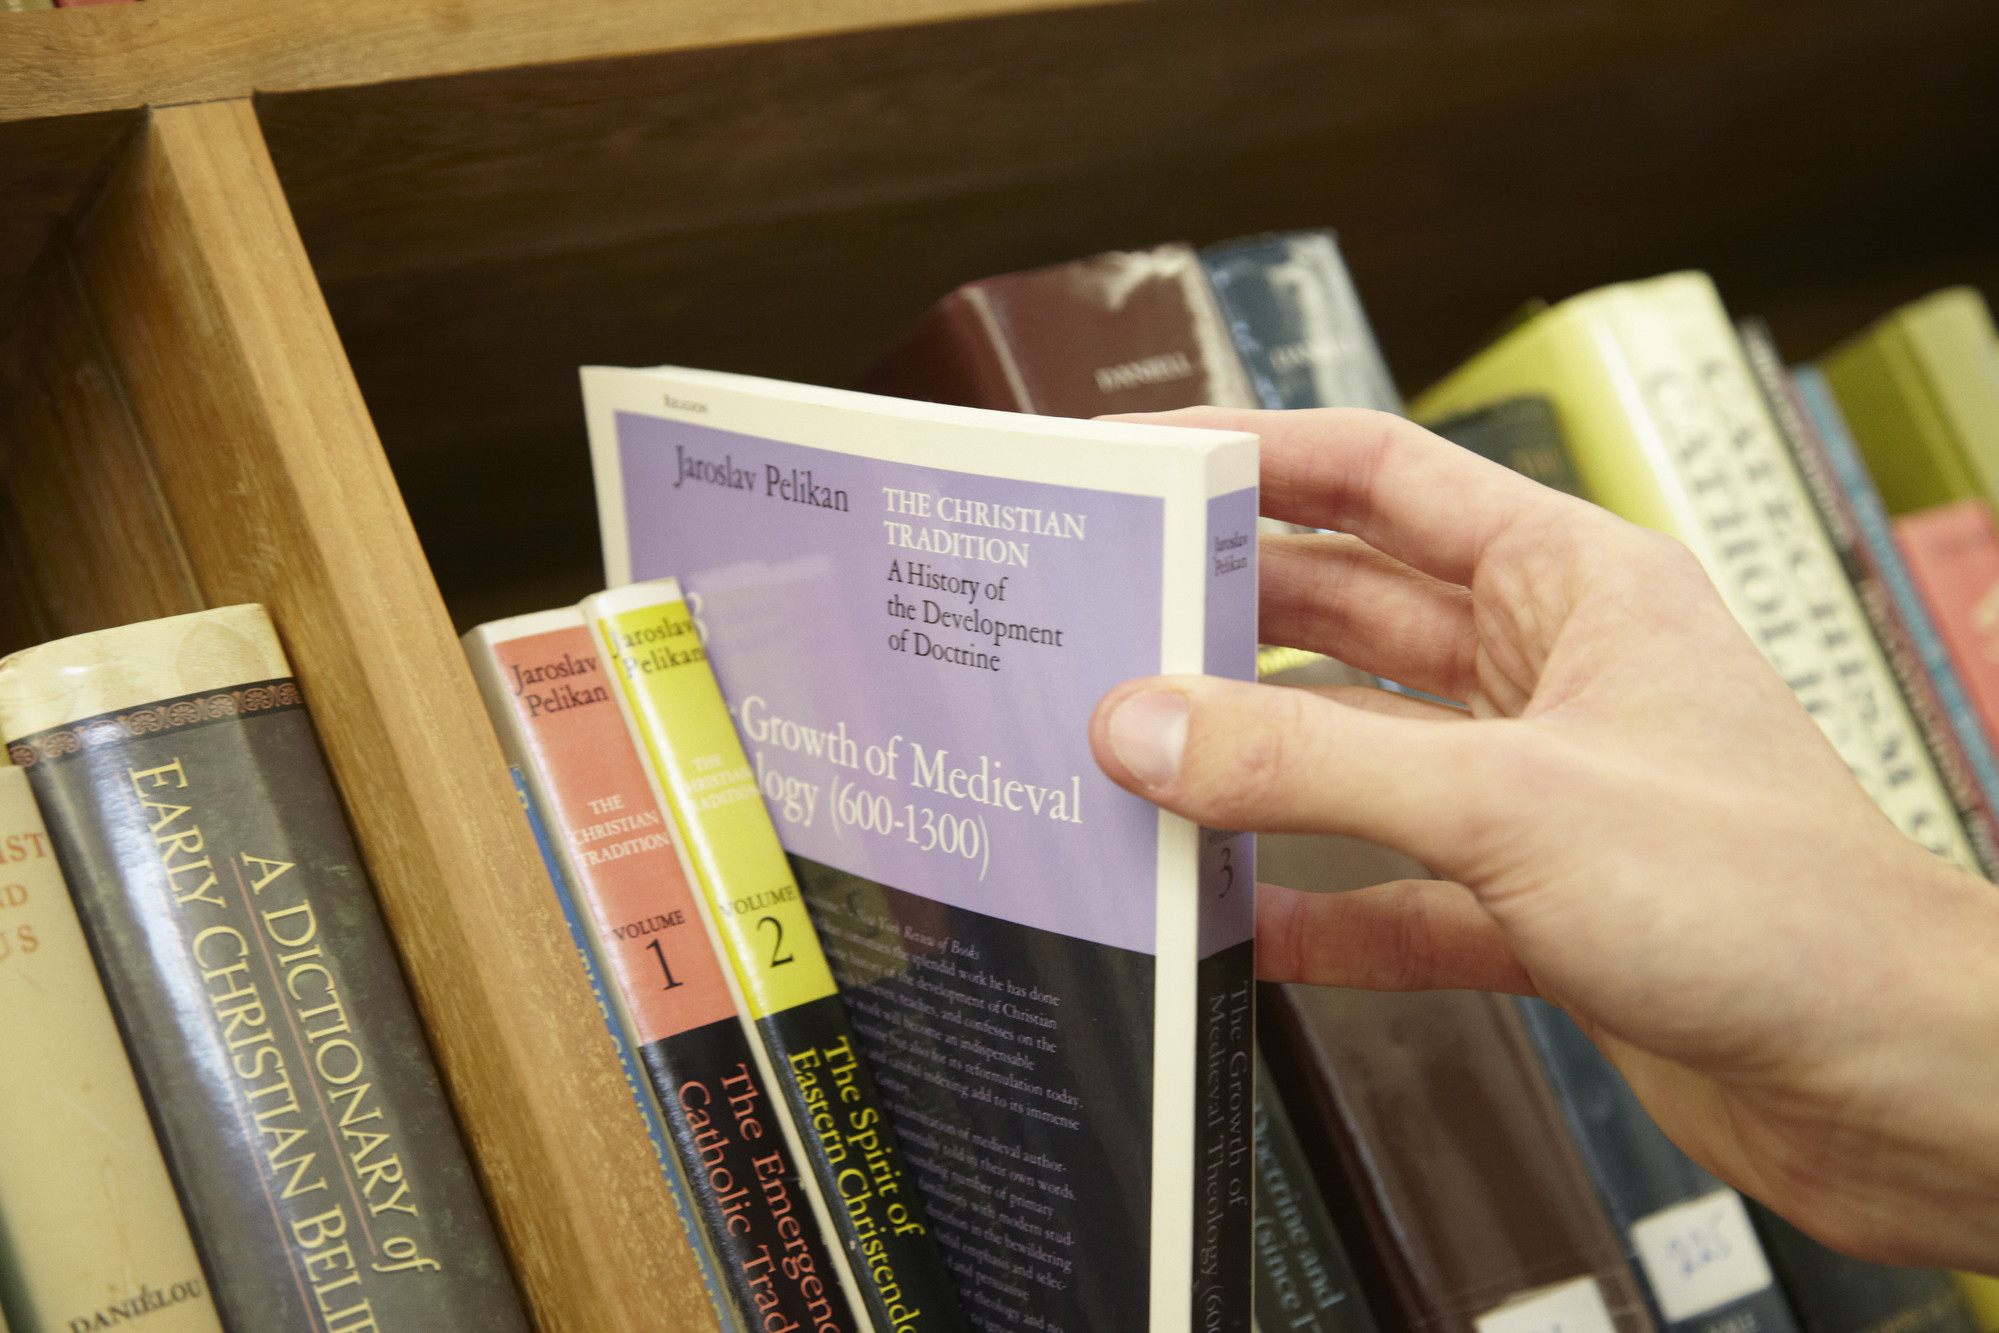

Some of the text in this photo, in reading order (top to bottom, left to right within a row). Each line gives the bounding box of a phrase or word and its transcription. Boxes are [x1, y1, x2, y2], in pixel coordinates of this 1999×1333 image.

[673, 444, 850, 512] Jaroslav Pelikan
[881, 486, 1086, 541] THE CHRISTIAN
[882, 520, 1030, 567] TRADITION
[887, 559, 1009, 606] A History of
[887, 595, 1064, 648] the Development
[512, 653, 598, 697] Jaroslav
[887, 629, 1001, 672] of Doctrine
[525, 684, 609, 718] Pelikan
[741, 696, 1084, 824] Growth of Medieval
[574, 809, 660, 846] CHRISTIAN
[587, 794, 625, 816] THE
[756, 751, 990, 882] logy (600-1300)
[576, 830, 671, 870] TRADITION
[1218, 847, 1234, 899] 3
[612, 909, 686, 941] VOLUME
[756, 916, 795, 969] 2
[129, 756, 227, 908] EARLY
[191, 925, 327, 1201] CHRISTIAN
[644, 938, 684, 991] 1
[958, 970, 987, 986] work
[989, 974, 1004, 991] he
[1006, 979, 1027, 998] has
[1028, 986, 1060, 1007] done
[916, 975, 985, 1010] development
[987, 1000, 1002, 1014] of
[1002, 1003, 1058, 1030] Christian
[941, 1009, 962, 1024] and
[963, 1018, 1015, 1041] confesses
[1016, 1034, 1034, 1047] on
[1036, 1036, 1058, 1053] the
[960, 1035, 1035, 1071] indispensable
[240, 852, 441, 1274] A DICTIONARY of
[964, 1061, 1043, 1096] reformulation
[1046, 1088, 1084, 1110] today.
[1207, 994, 1227, 1128] Medieval
[720, 1062, 764, 1142] The
[787, 1047, 848, 1167] Eastern
[970, 1086, 992, 1103] add
[994, 1096, 1008, 1108] to
[1009, 1097, 1025, 1114] its
[1025, 1102, 1081, 1131] immense
[1229, 979, 1249, 1206] The Growth of
[678, 1081, 751, 1238] Catholic
[823, 1035, 860, 1104] The
[846, 1107, 903, 1198] Spirit
[886, 1203, 926, 1238] of
[972, 1135, 1021, 1160] medieval
[980, 1157, 1008, 1177] their
[1009, 1171, 1036, 1188] own
[1037, 1183, 1078, 1201] words.
[999, 1213, 1043, 1237] modern
[1009, 1194, 1056, 1220] primary
[1200, 1134, 1225, 1276] Theology
[1004, 1233, 1074, 1275] bewildering
[1298, 1250, 1348, 1310] and
